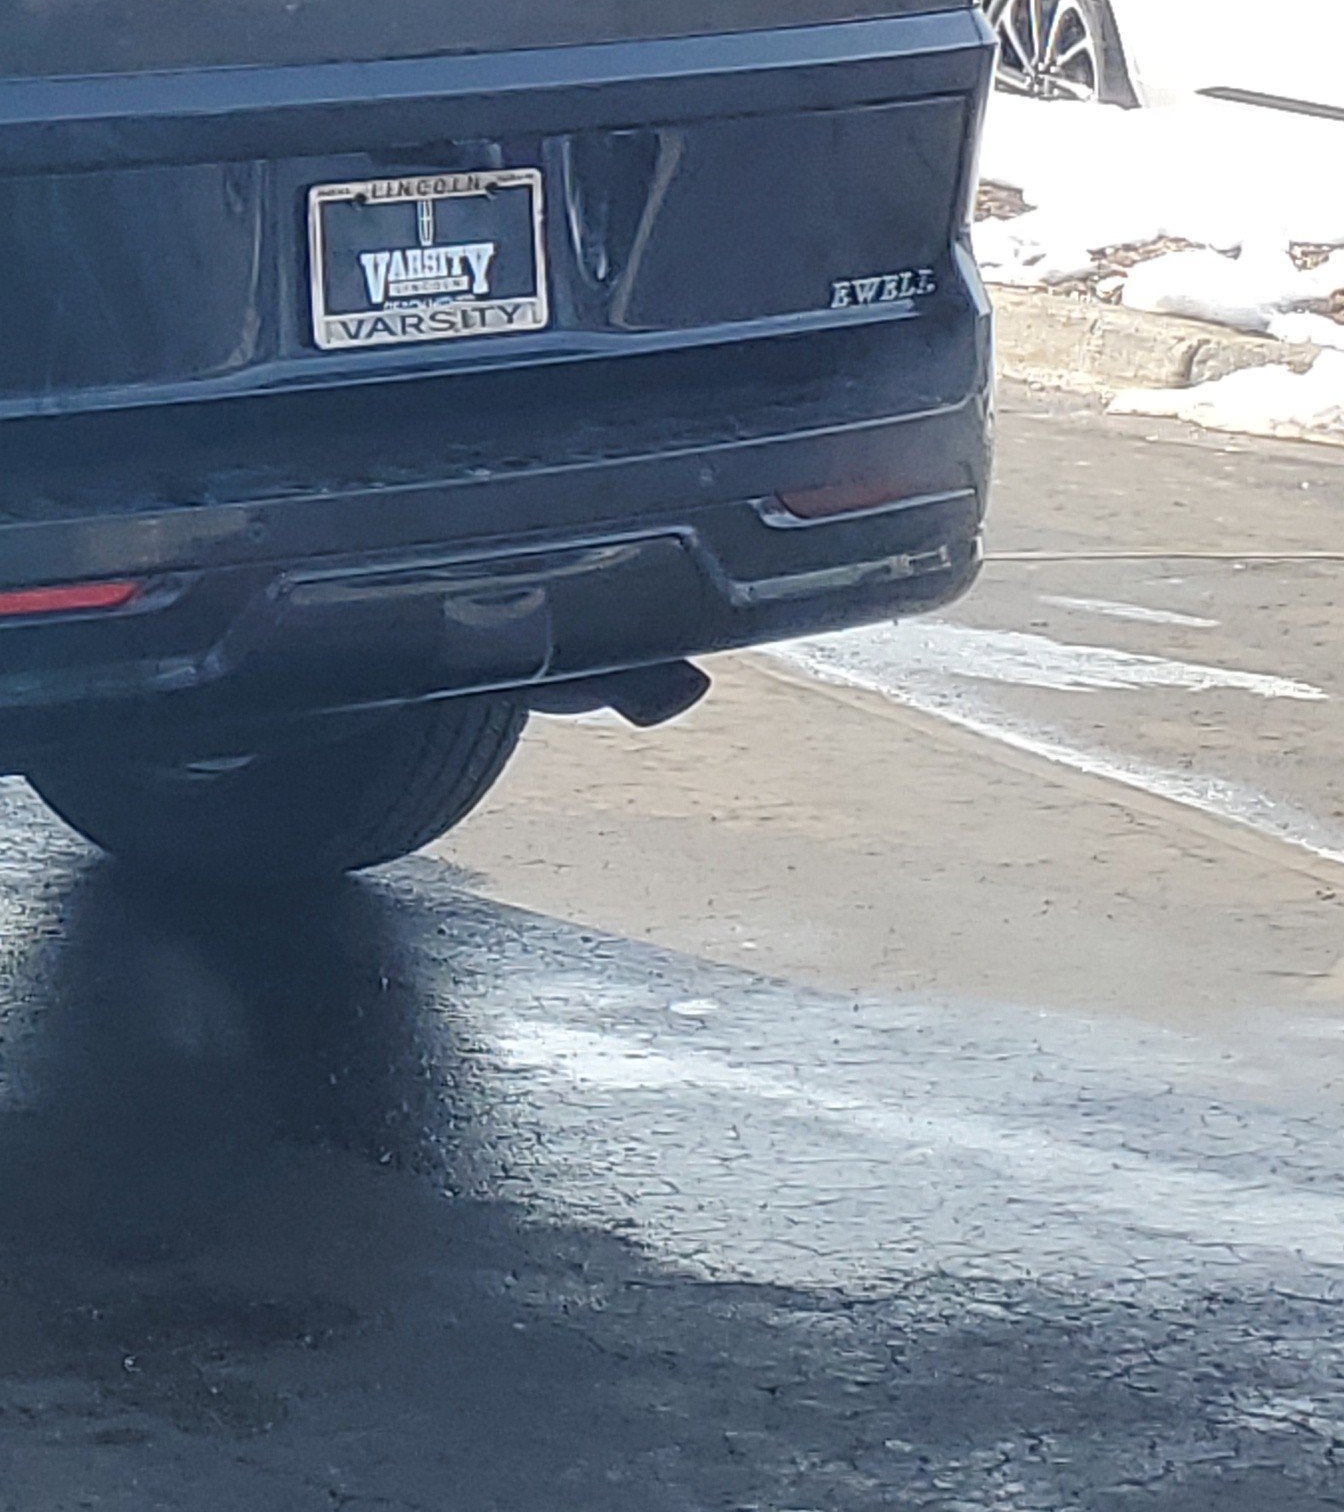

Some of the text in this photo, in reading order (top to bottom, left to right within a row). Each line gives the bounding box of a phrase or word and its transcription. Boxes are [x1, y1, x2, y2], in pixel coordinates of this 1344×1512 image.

[370, 175, 481, 200] LINCOLN
[359, 241, 494, 305] VARSITY
[339, 304, 522, 340] VARSITY
